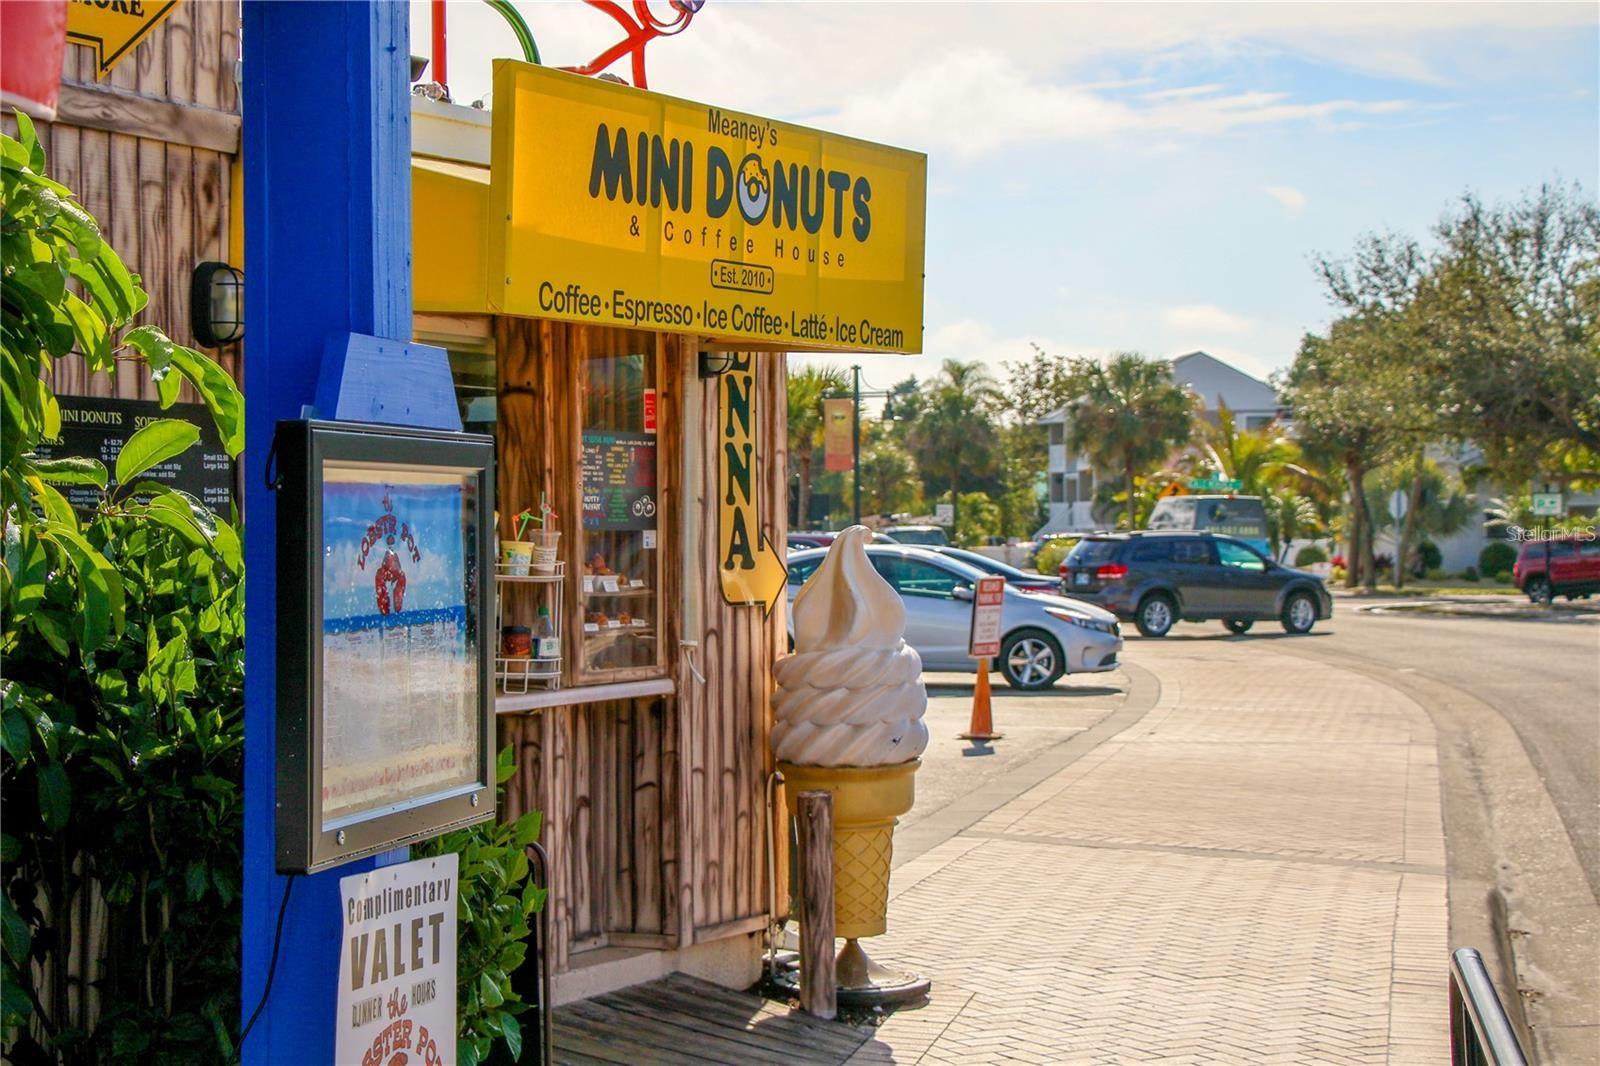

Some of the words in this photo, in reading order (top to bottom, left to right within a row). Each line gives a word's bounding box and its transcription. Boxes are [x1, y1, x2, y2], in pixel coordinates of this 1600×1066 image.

[708, 109, 778, 149] Meaney's
[588, 122, 693, 214] MINI
[706, 146, 872, 242] DONUTS
[629, 215, 640, 237] &
[663, 221, 754, 254] Coffee
[774, 239, 845, 267] House
[720, 266, 738, 284] Est.
[741, 269, 765, 288] 2010
[538, 281, 602, 317] Coffee
[612, 290, 694, 326] Espresso
[703, 300, 728, 330] Ice
[731, 304, 783, 335] Coffee
[791, 311, 828, 340] Latté
[836, 316, 857, 343] Ice
[859, 320, 904, 348] Cream
[81, 410, 122, 424] DONUTS
[347, 878, 451, 925] Complimentary
[350, 911, 445, 992] VALET
[387, 986, 409, 1020] the
[411, 978, 438, 1008] HOURS
